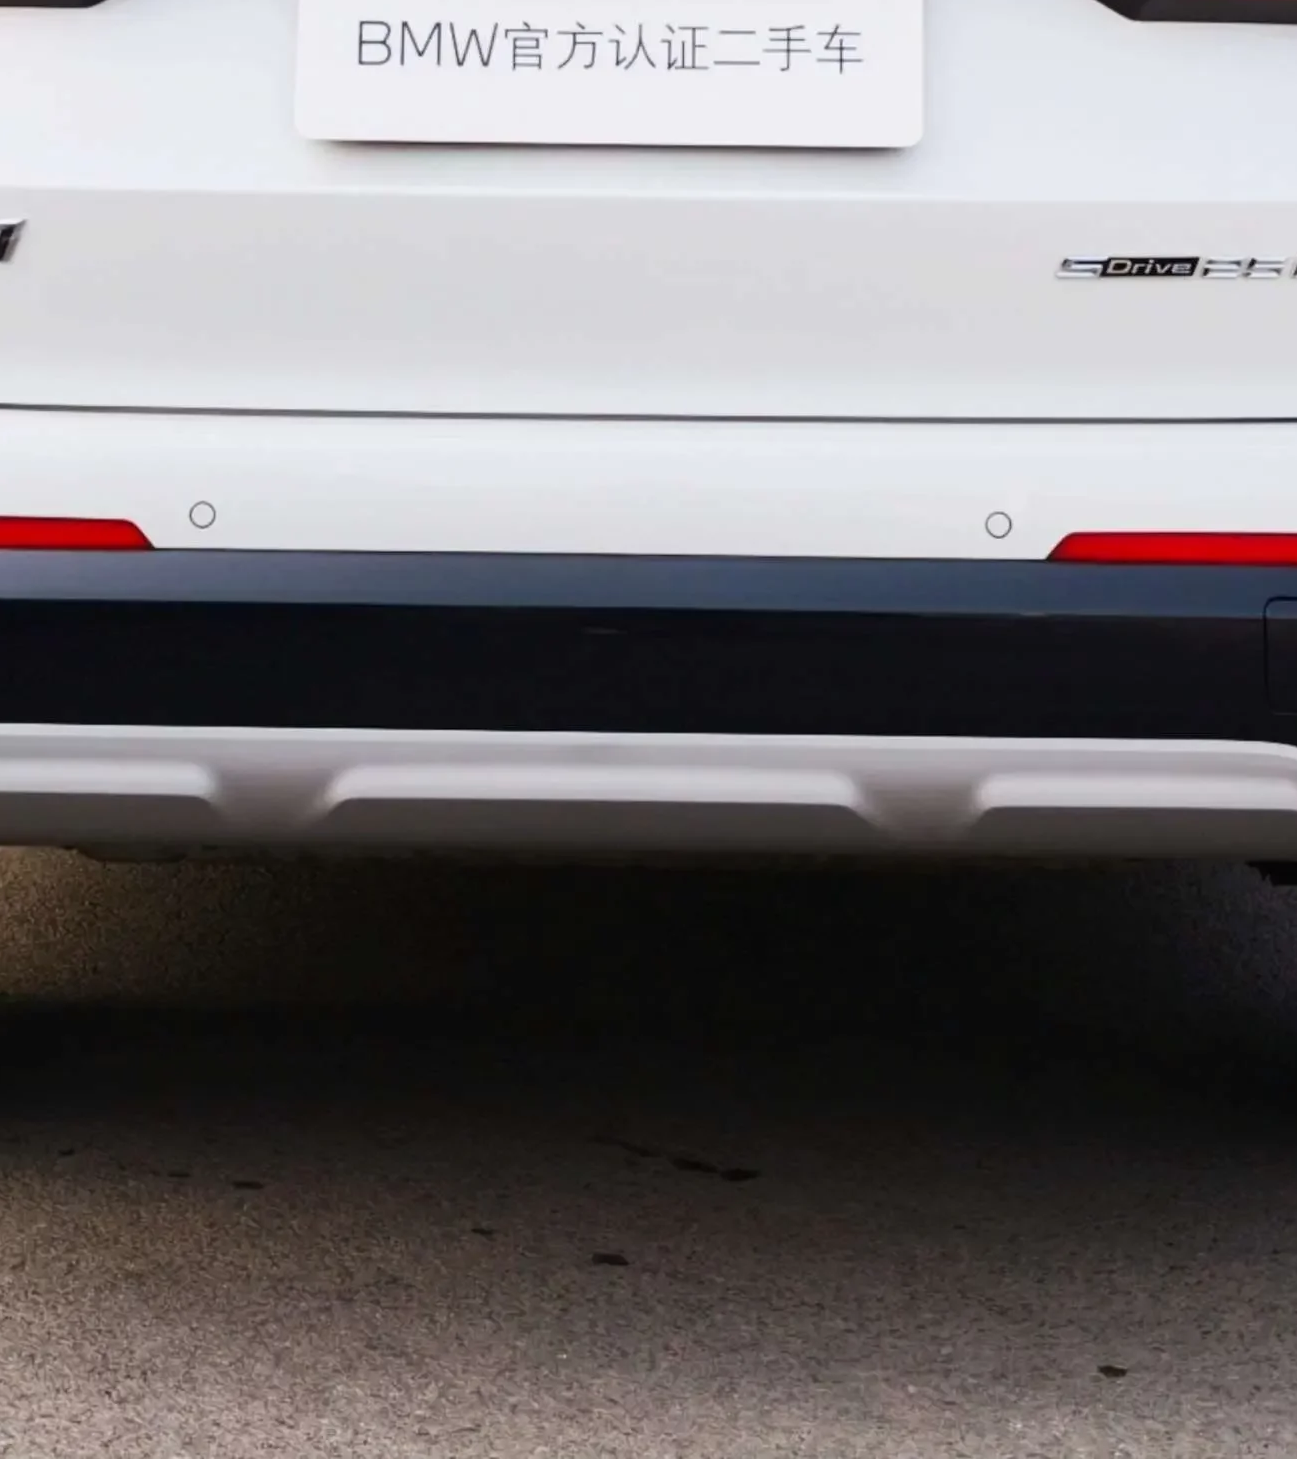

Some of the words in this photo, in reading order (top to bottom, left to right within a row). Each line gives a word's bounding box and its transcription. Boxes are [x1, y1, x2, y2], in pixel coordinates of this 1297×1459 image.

[356, 20, 865, 74] BMW官方认证二手车
